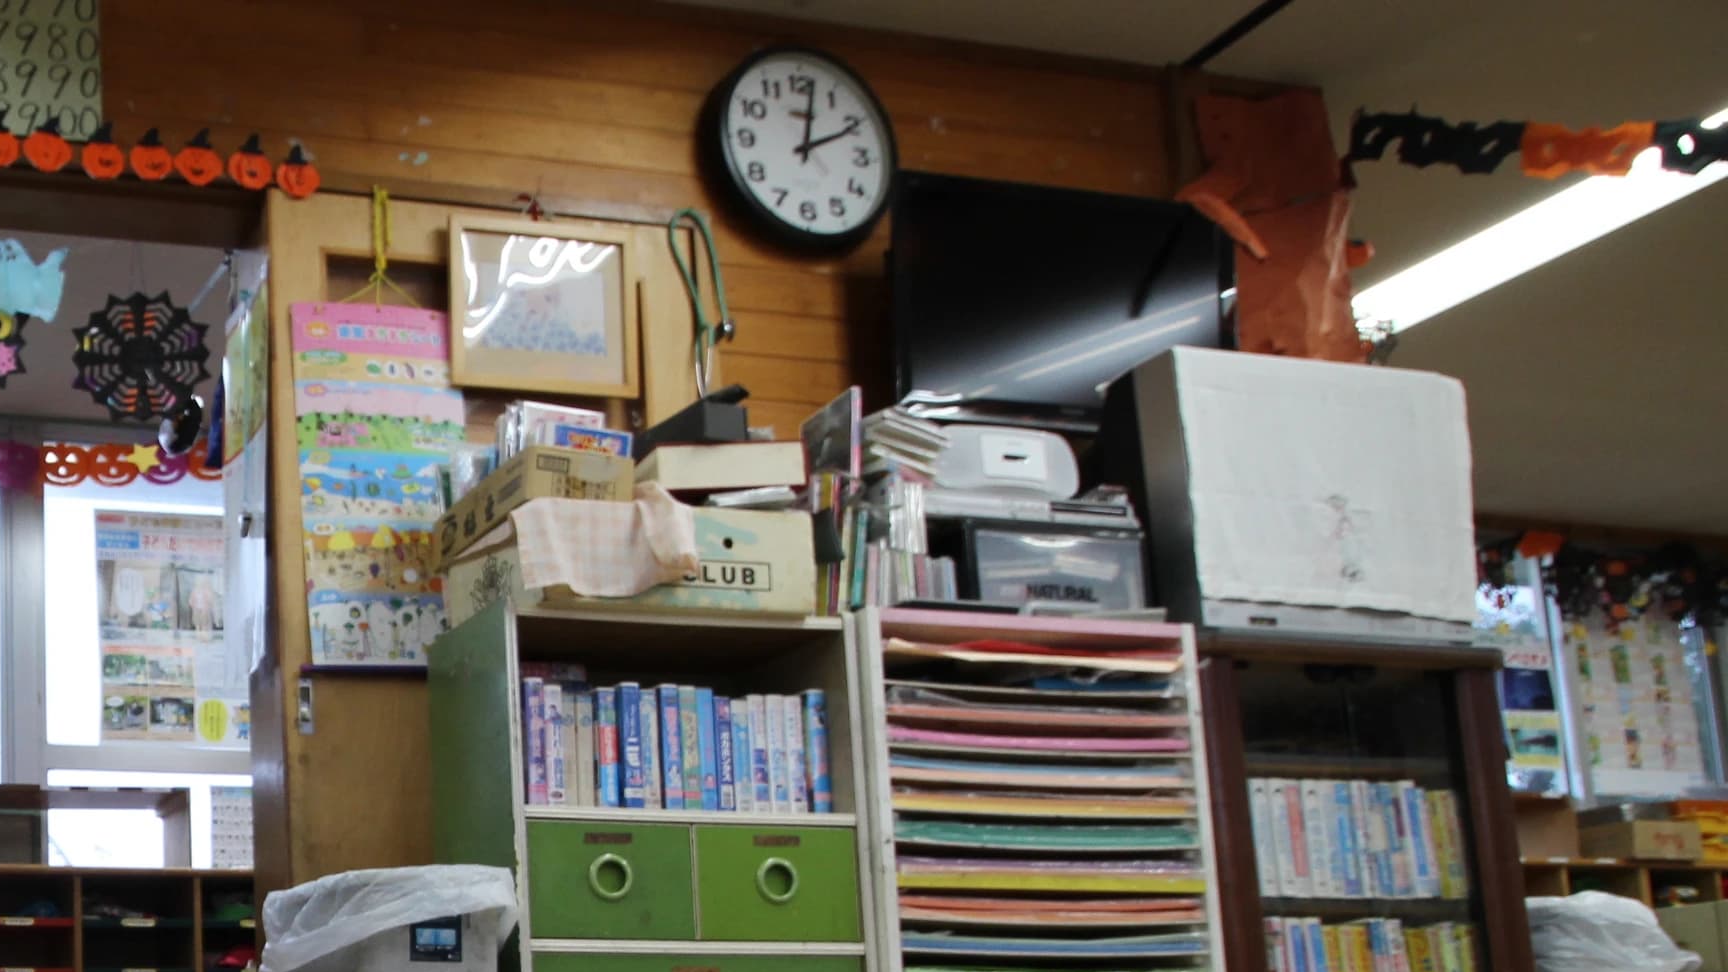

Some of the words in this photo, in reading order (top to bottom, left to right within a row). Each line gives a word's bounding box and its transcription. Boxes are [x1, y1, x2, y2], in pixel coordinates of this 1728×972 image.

[47, 22, 98, 62] 80
[47, 64, 99, 99] 90
[761, 80, 781, 100] 11
[788, 74, 814, 95] 12
[741, 99, 767, 120] 10
[827, 91, 836, 109] 1
[737, 128, 756, 149] 9
[853, 148, 870, 168] 3
[747, 162, 765, 183] 8
[772, 188, 788, 207] 7
[848, 178, 865, 198] 4
[799, 202, 817, 222] 6
[829, 198, 846, 217] 5
